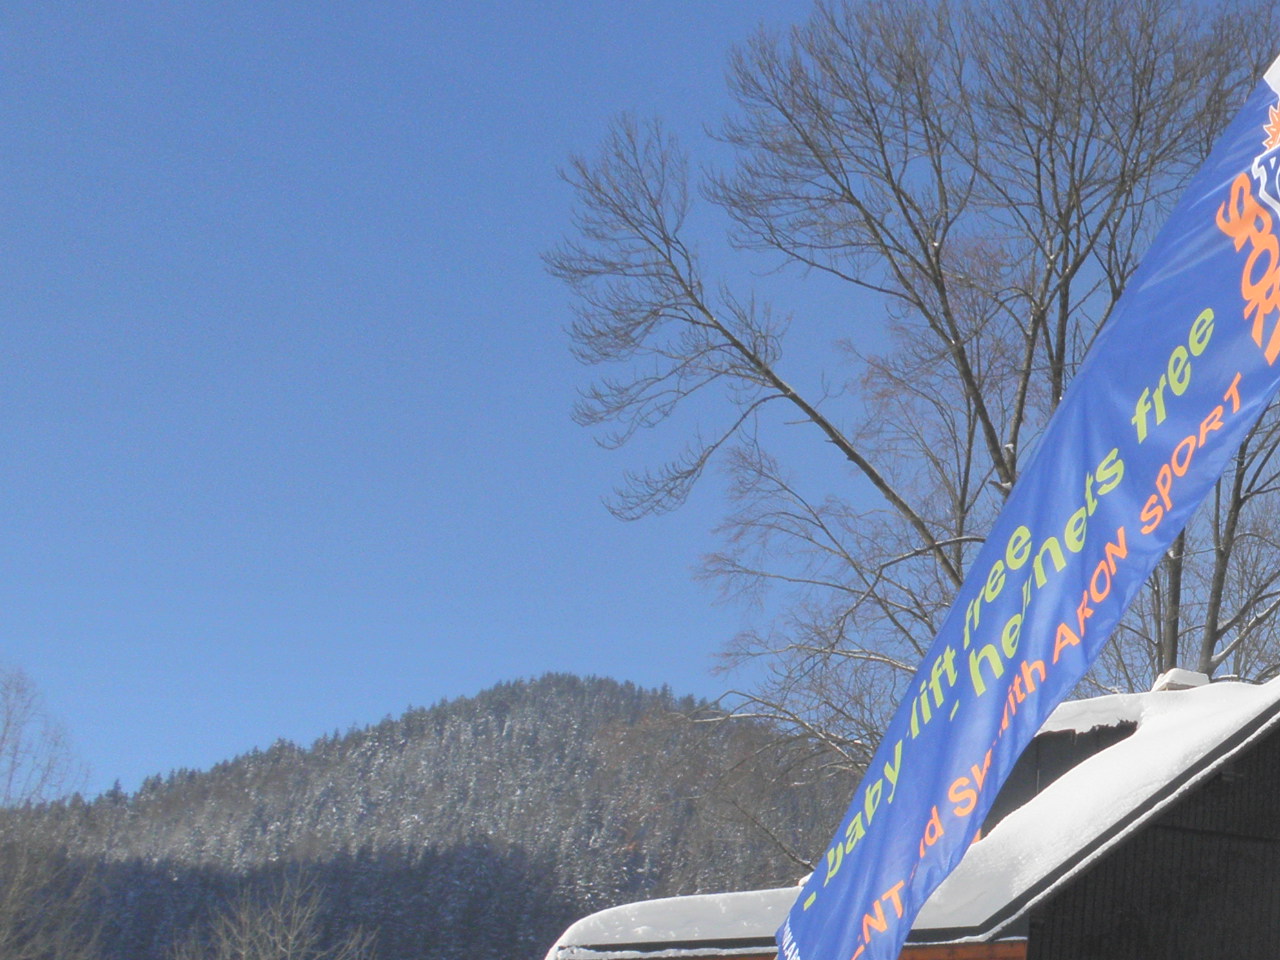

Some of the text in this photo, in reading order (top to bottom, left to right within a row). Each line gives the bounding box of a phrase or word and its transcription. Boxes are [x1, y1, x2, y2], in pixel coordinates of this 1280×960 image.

[1131, 307, 1214, 444] free
[1140, 372, 1242, 535] SPORT
[964, 525, 1032, 650] free
